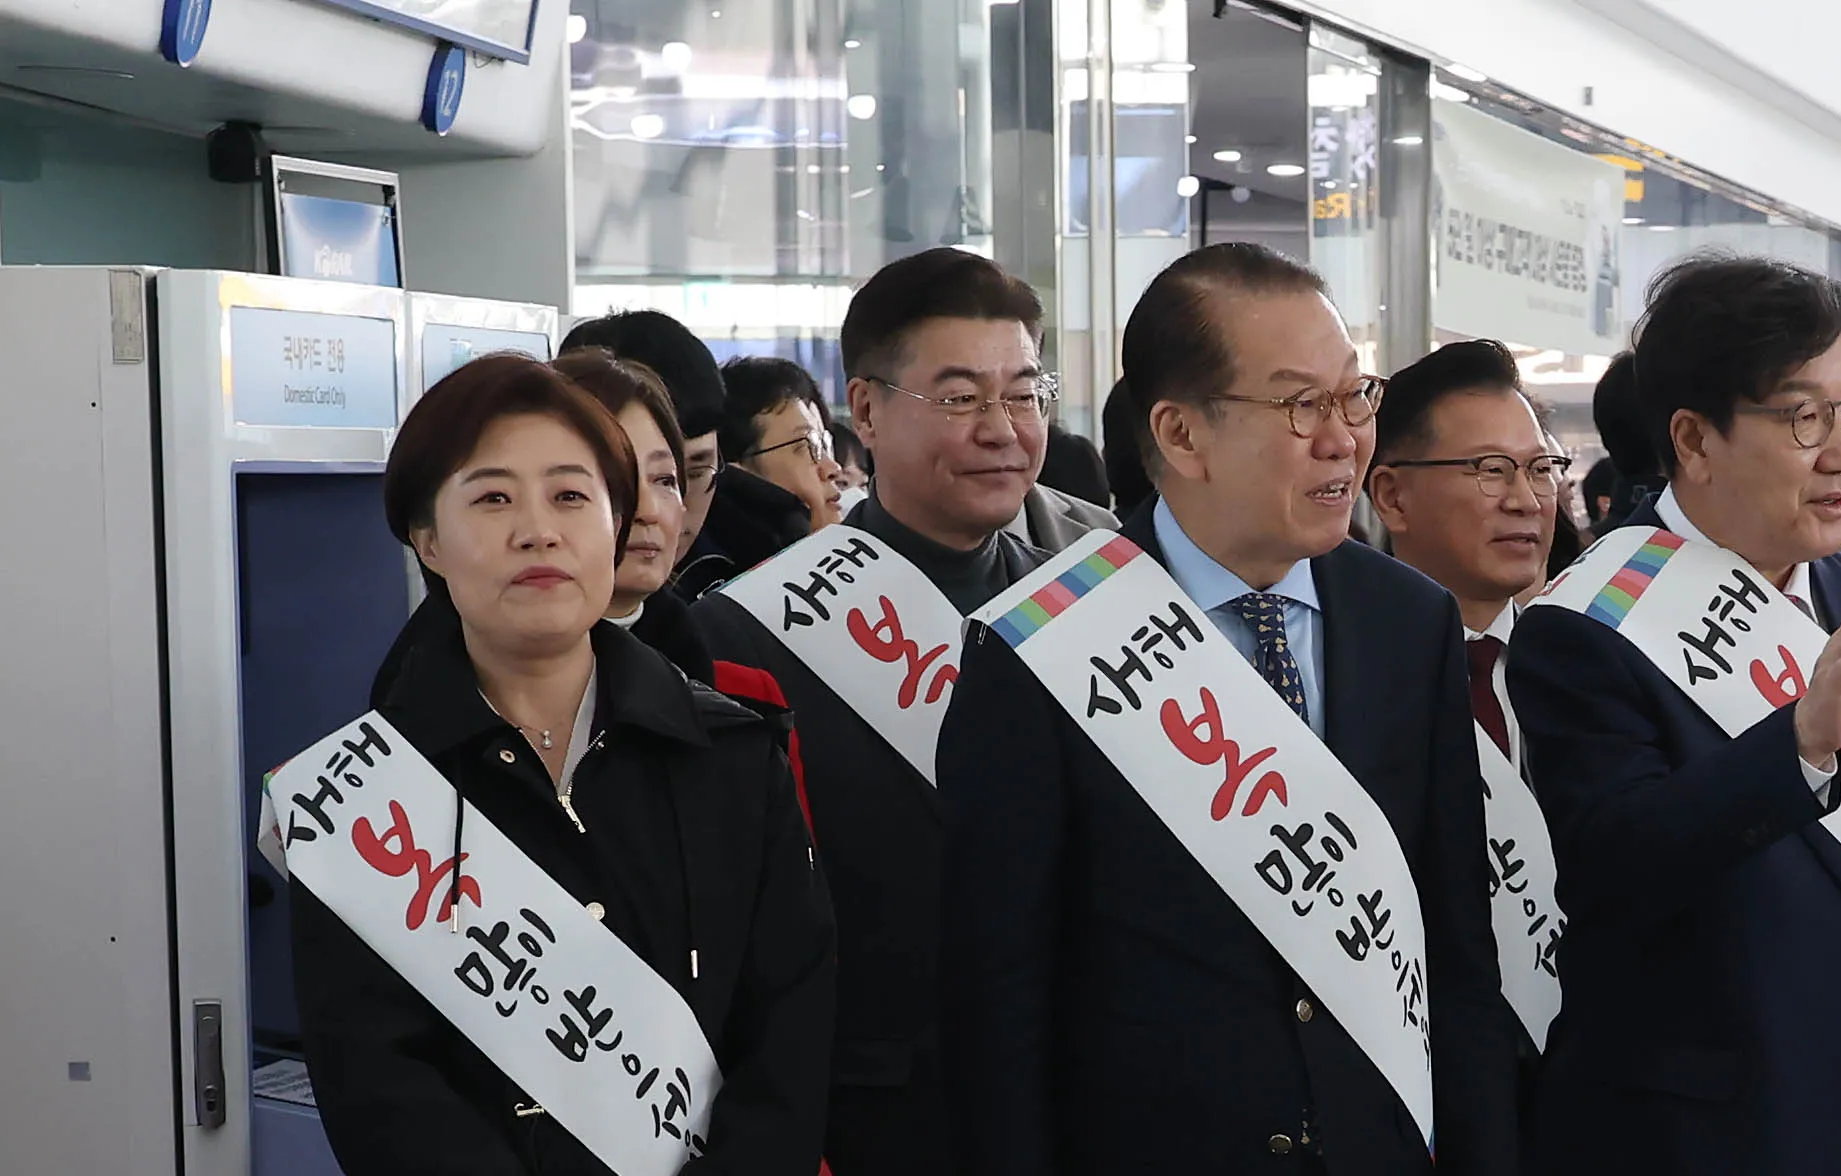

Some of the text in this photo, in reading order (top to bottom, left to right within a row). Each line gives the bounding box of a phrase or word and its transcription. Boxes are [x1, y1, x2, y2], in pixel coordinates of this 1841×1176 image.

[441, 69, 459, 117] 12
[284, 335, 344, 374] 국내카드 전용
[285, 384, 346, 410] Domestic Card Only
[782, 537, 960, 710] 새해 복
[1678, 568, 1770, 687] 새해
[1087, 601, 1204, 720] 새해
[1160, 686, 1289, 822] 복
[1254, 811, 1358, 917] 많이
[285, 720, 392, 850] 새해
[351, 799, 483, 931] 복
[454, 908, 556, 1018] 많이
